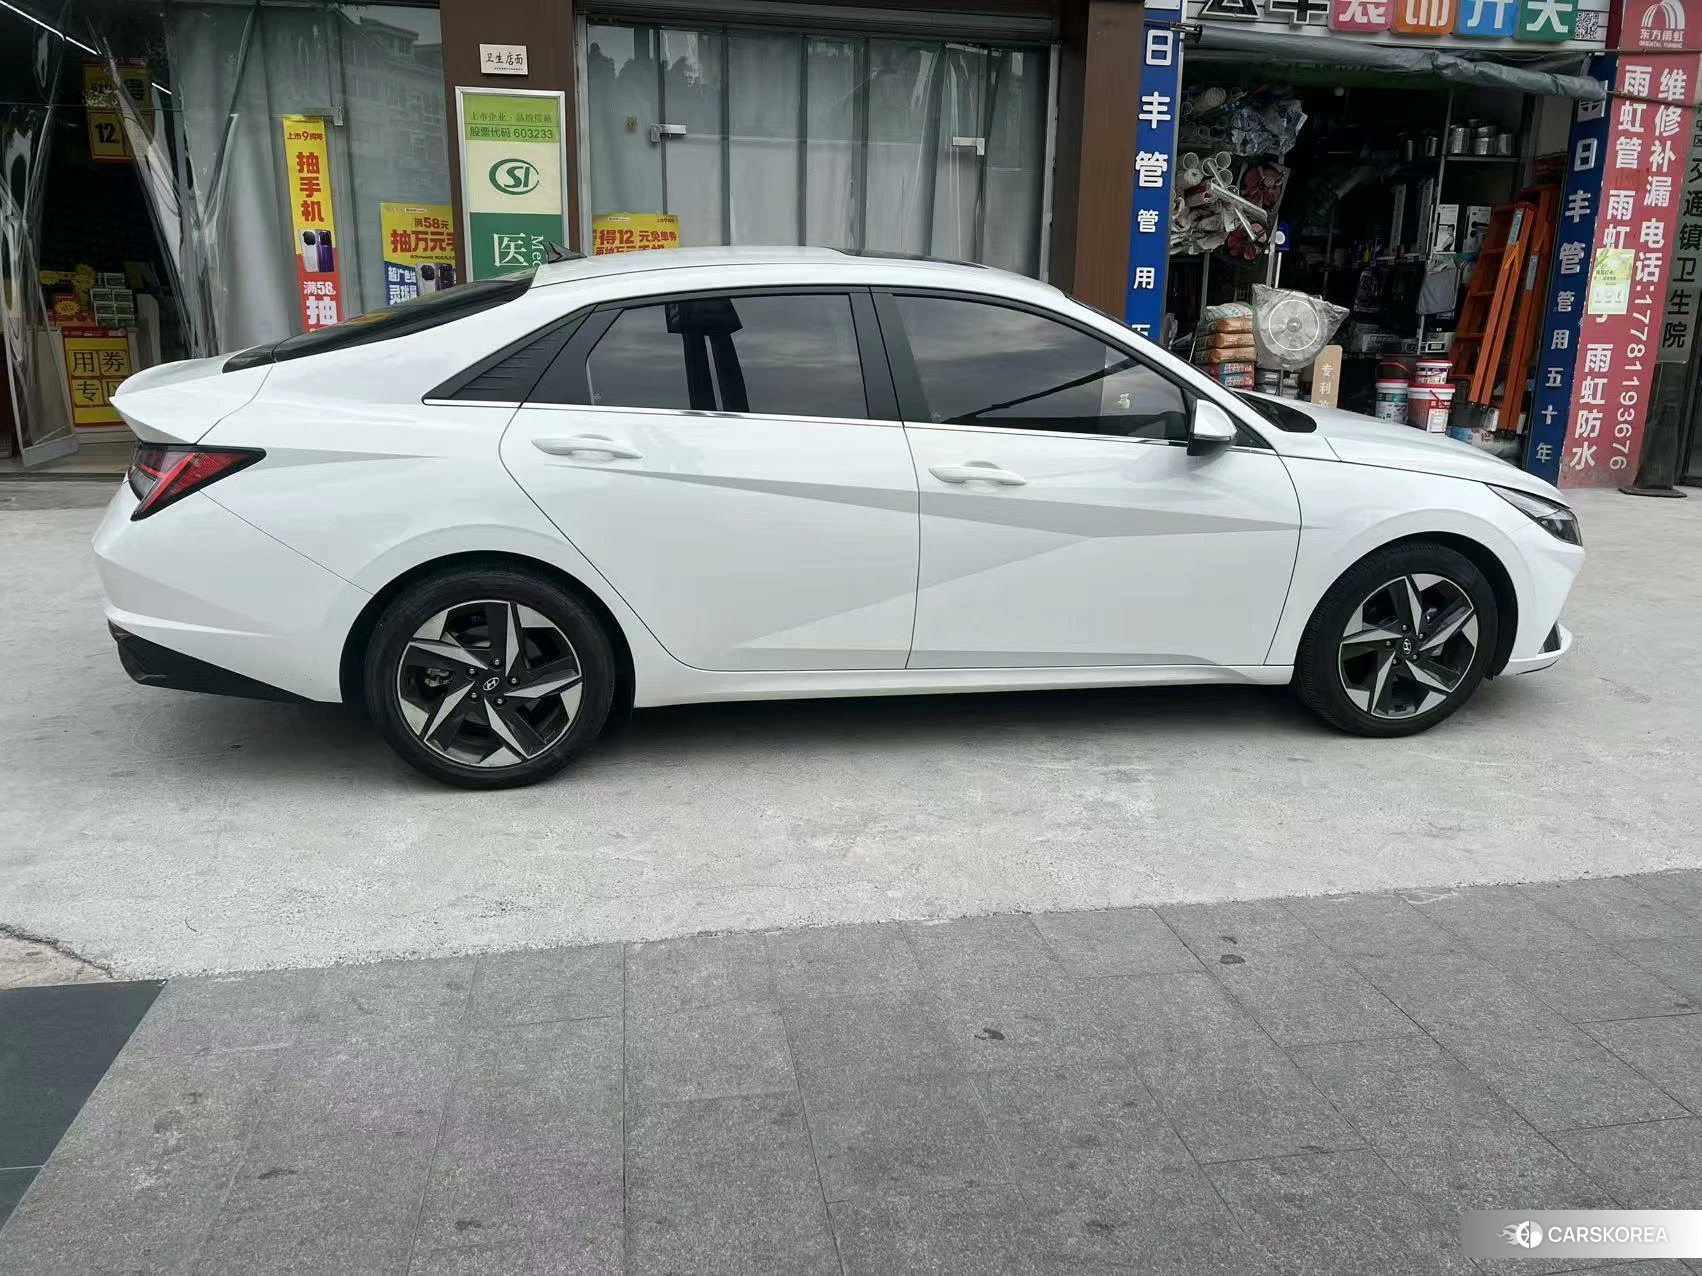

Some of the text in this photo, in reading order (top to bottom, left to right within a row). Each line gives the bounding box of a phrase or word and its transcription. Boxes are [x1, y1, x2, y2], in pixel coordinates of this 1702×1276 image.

[1640, 29, 1684, 42] 东方雨虹
[485, 52, 523, 66] 卫生店面
[470, 126, 553, 139] 股票代码 603233
[296, 151, 325, 223] 抽手机
[492, 232, 530, 268] 医
[305, 295, 338, 325] 抽
[1569, 343, 1614, 471] 雨虹防水
